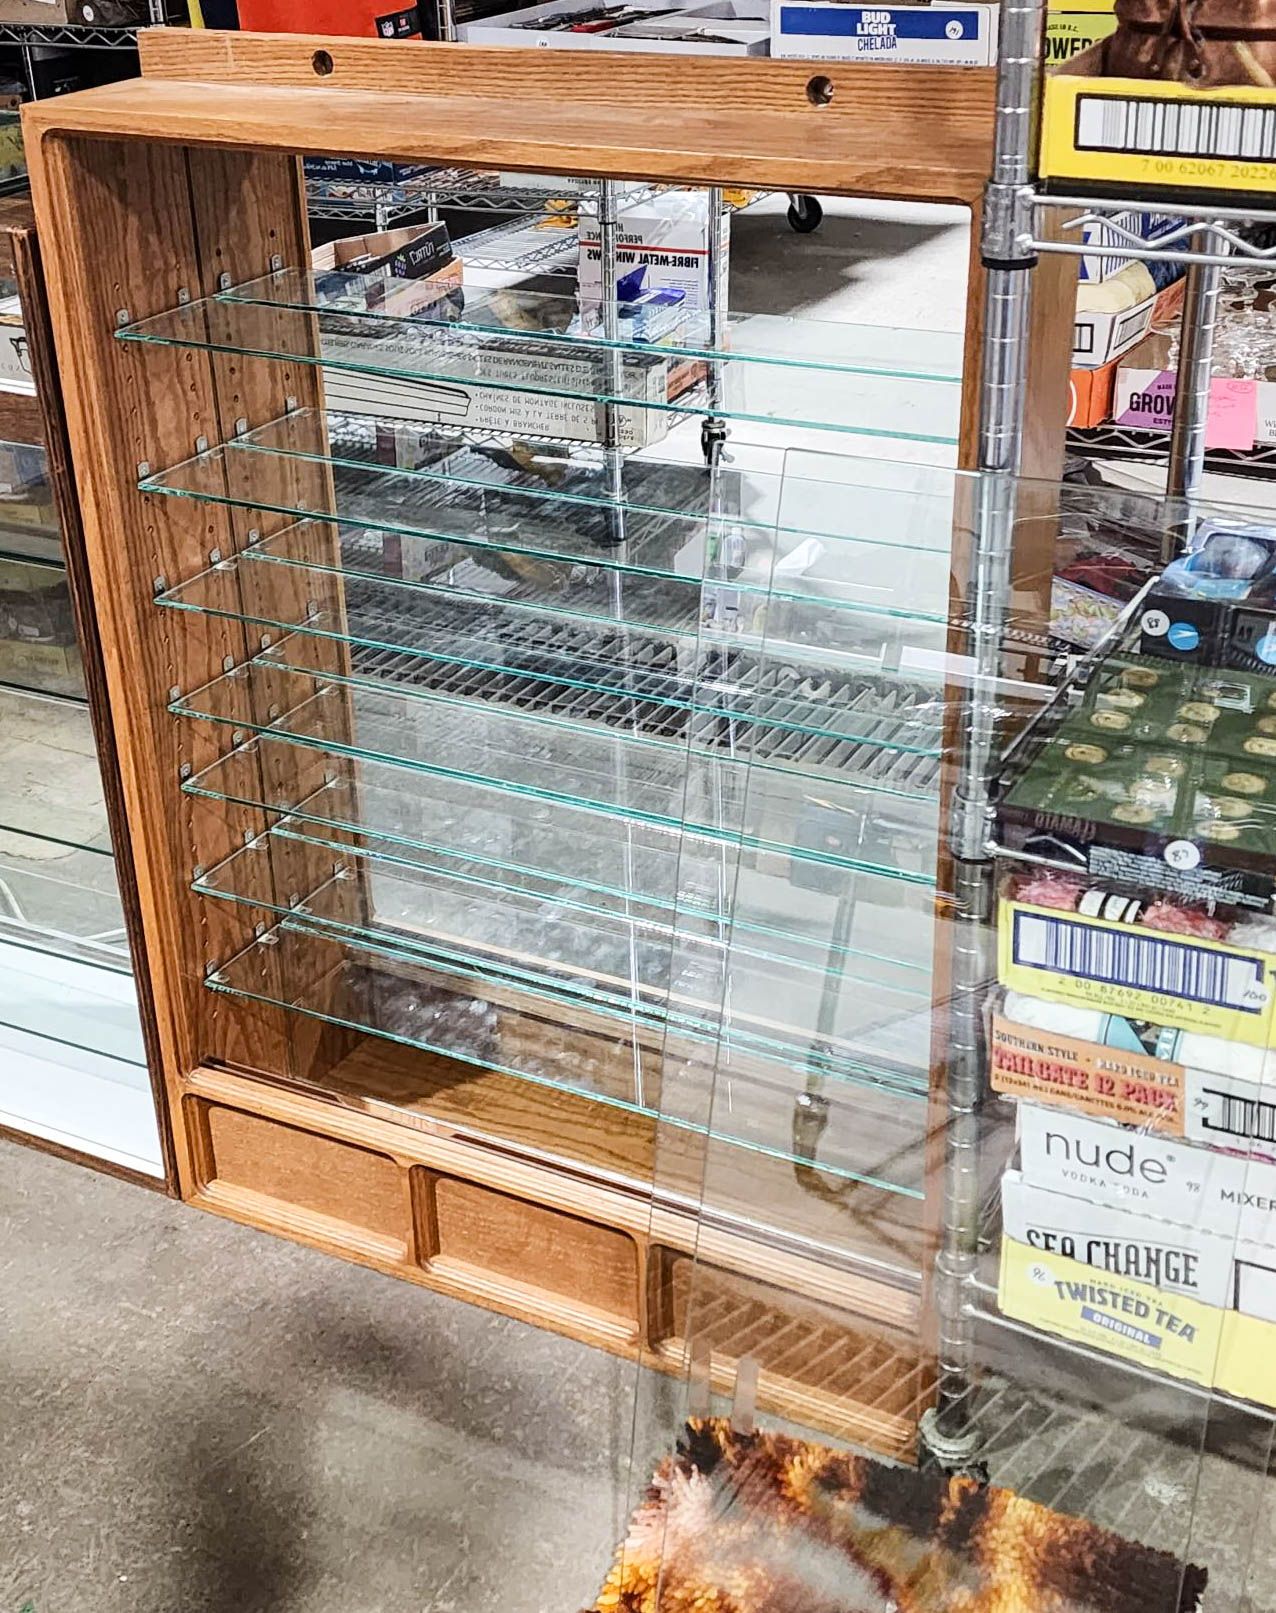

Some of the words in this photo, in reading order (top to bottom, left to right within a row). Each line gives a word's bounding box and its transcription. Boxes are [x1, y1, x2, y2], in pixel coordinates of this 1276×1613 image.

[857, 23, 897, 36] LIGHT
[861, 11, 891, 24] BUD
[857, 35, 897, 52] CHELADA
[1141, 158, 1150, 172] 7
[1155, 160, 1174, 173] 00
[1179, 162, 1225, 177] 62067
[995, 1030, 1044, 1053] SOUTHERN
[1045, 1045, 1078, 1061] STYLE
[994, 1047, 1090, 1091] TAILGATE
[1094, 1073, 1116, 1097] 12
[1121, 1079, 1178, 1112] PACK
[1046, 1132, 1168, 1184] nude
[1061, 1168, 1107, 1188] VODKA
[1087, 1240, 1200, 1288] CHANGE
[1054, 1281, 1150, 1319] TWISTED
[1155, 1308, 1197, 1344] TEA
[1092, 1311, 1151, 1344] ORIGINAL
